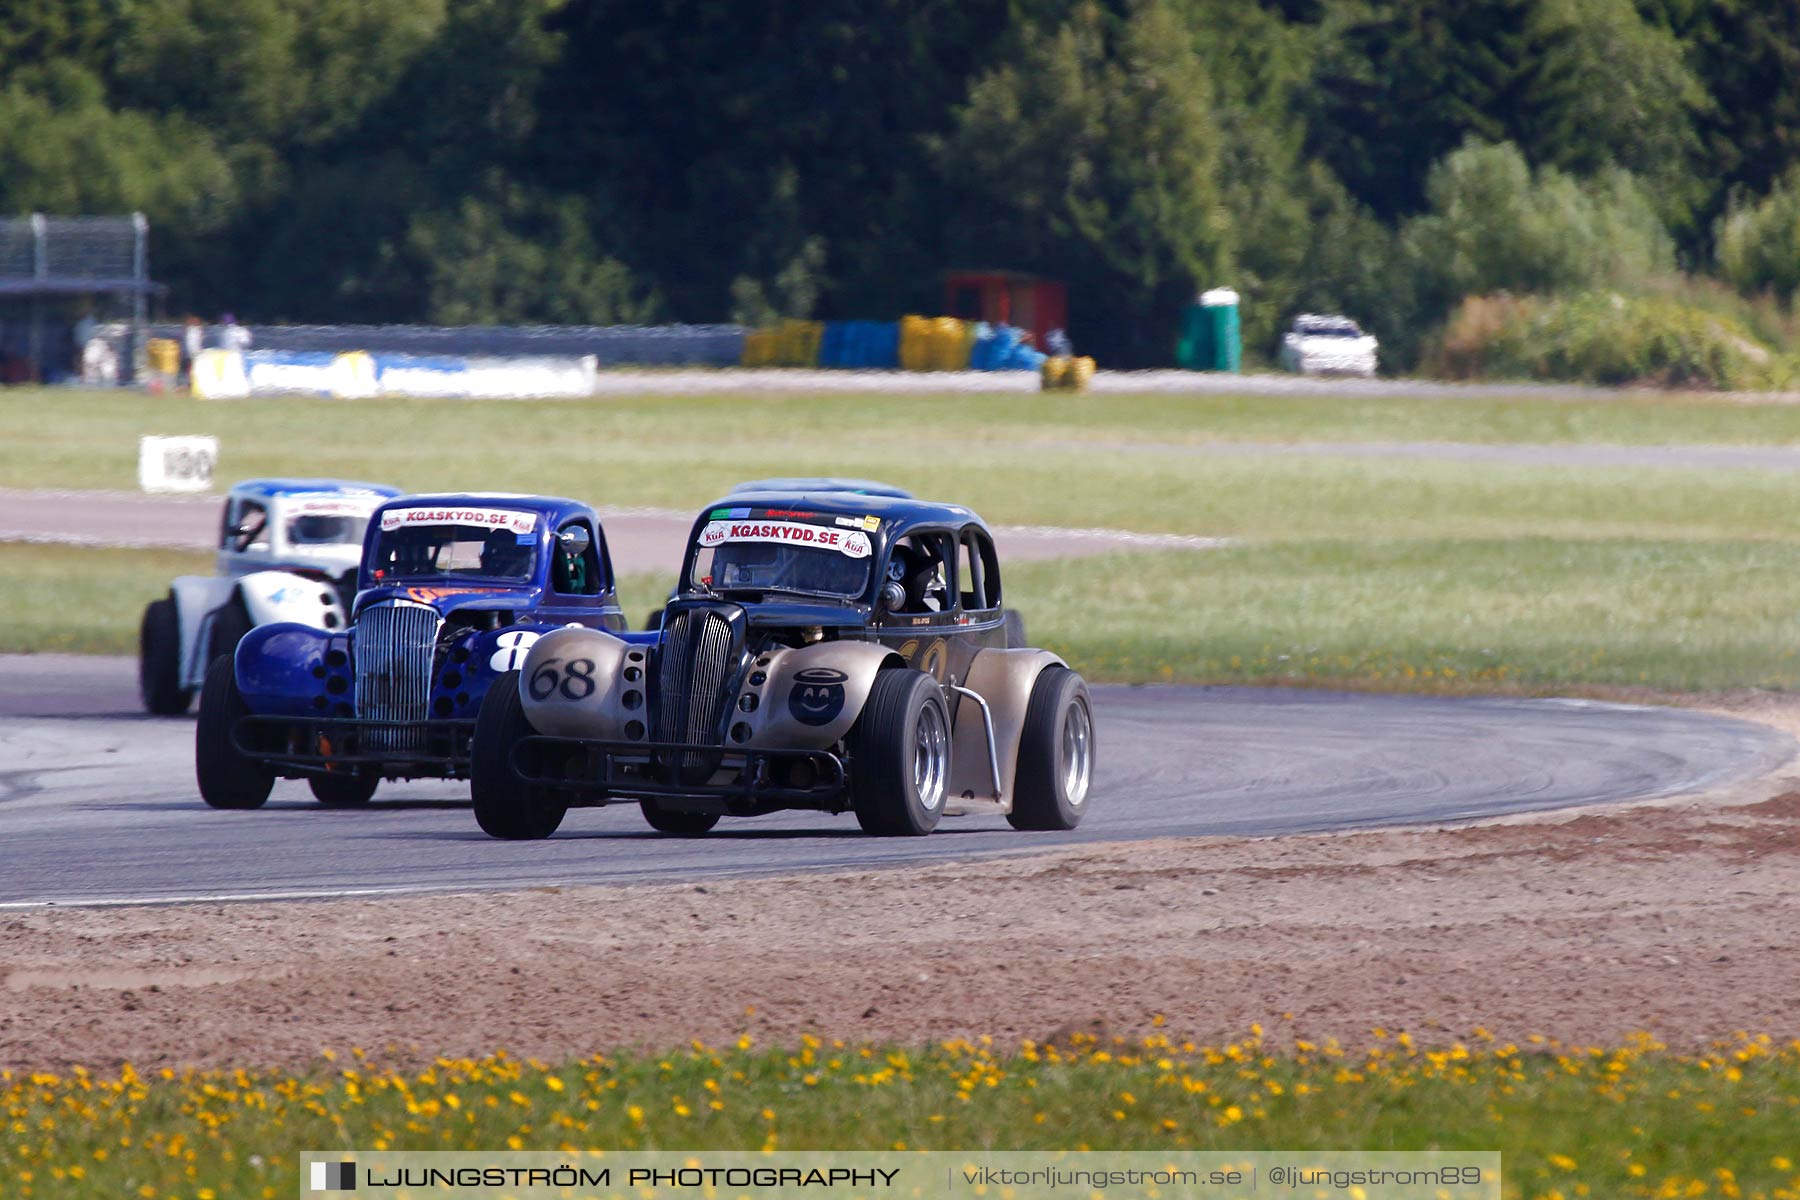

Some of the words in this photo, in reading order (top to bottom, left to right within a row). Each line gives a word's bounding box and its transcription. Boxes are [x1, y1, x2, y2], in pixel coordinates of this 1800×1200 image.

[406, 510, 508, 525] KGASKYDD.SE
[730, 524, 840, 546] KGASKYDD.SE
[529, 658, 596, 702] 68
